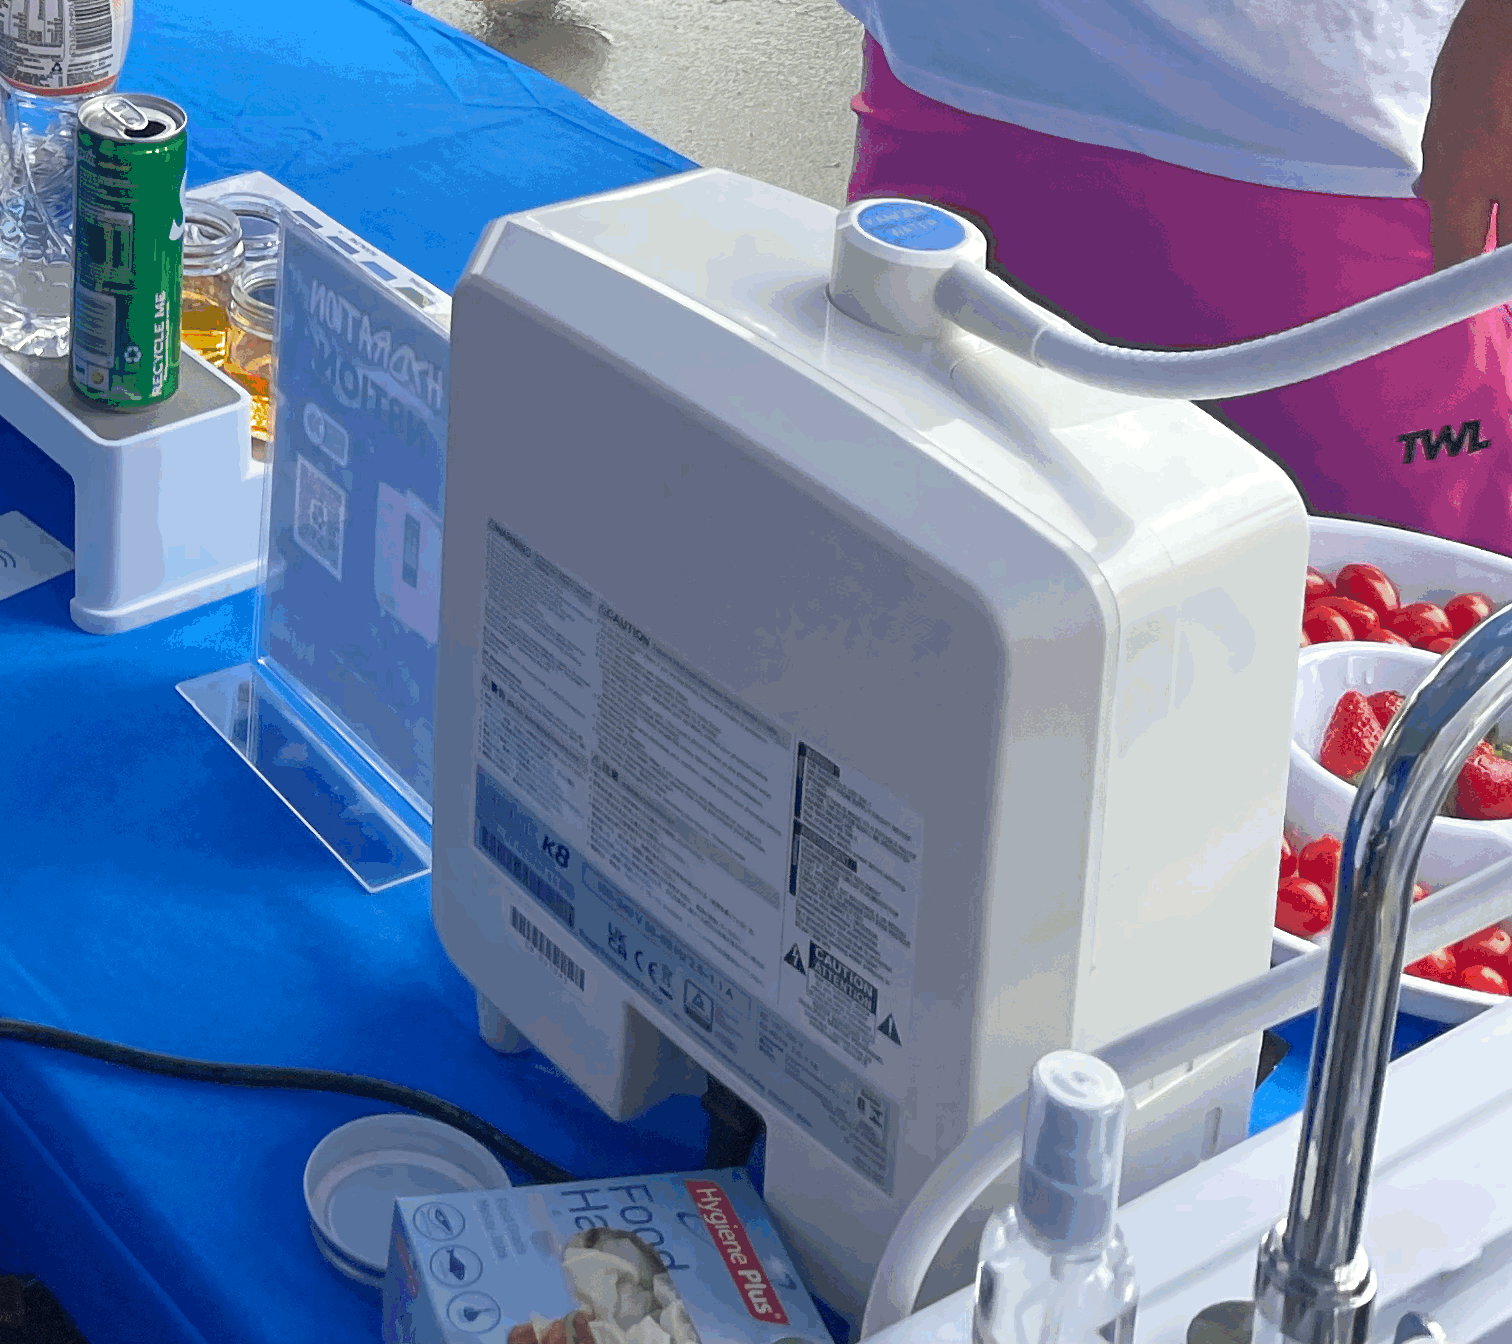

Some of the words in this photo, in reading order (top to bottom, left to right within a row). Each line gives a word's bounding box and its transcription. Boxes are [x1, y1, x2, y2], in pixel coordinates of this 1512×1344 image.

[155, 290, 166, 317] ME
[152, 321, 165, 397] RECYCLE
[1397, 418, 1492, 465] TWL
[542, 834, 571, 870] K8
[813, 944, 875, 996] CAUTION
[608, 1183, 690, 1272] Food
[696, 1186, 747, 1266] Hygiene
